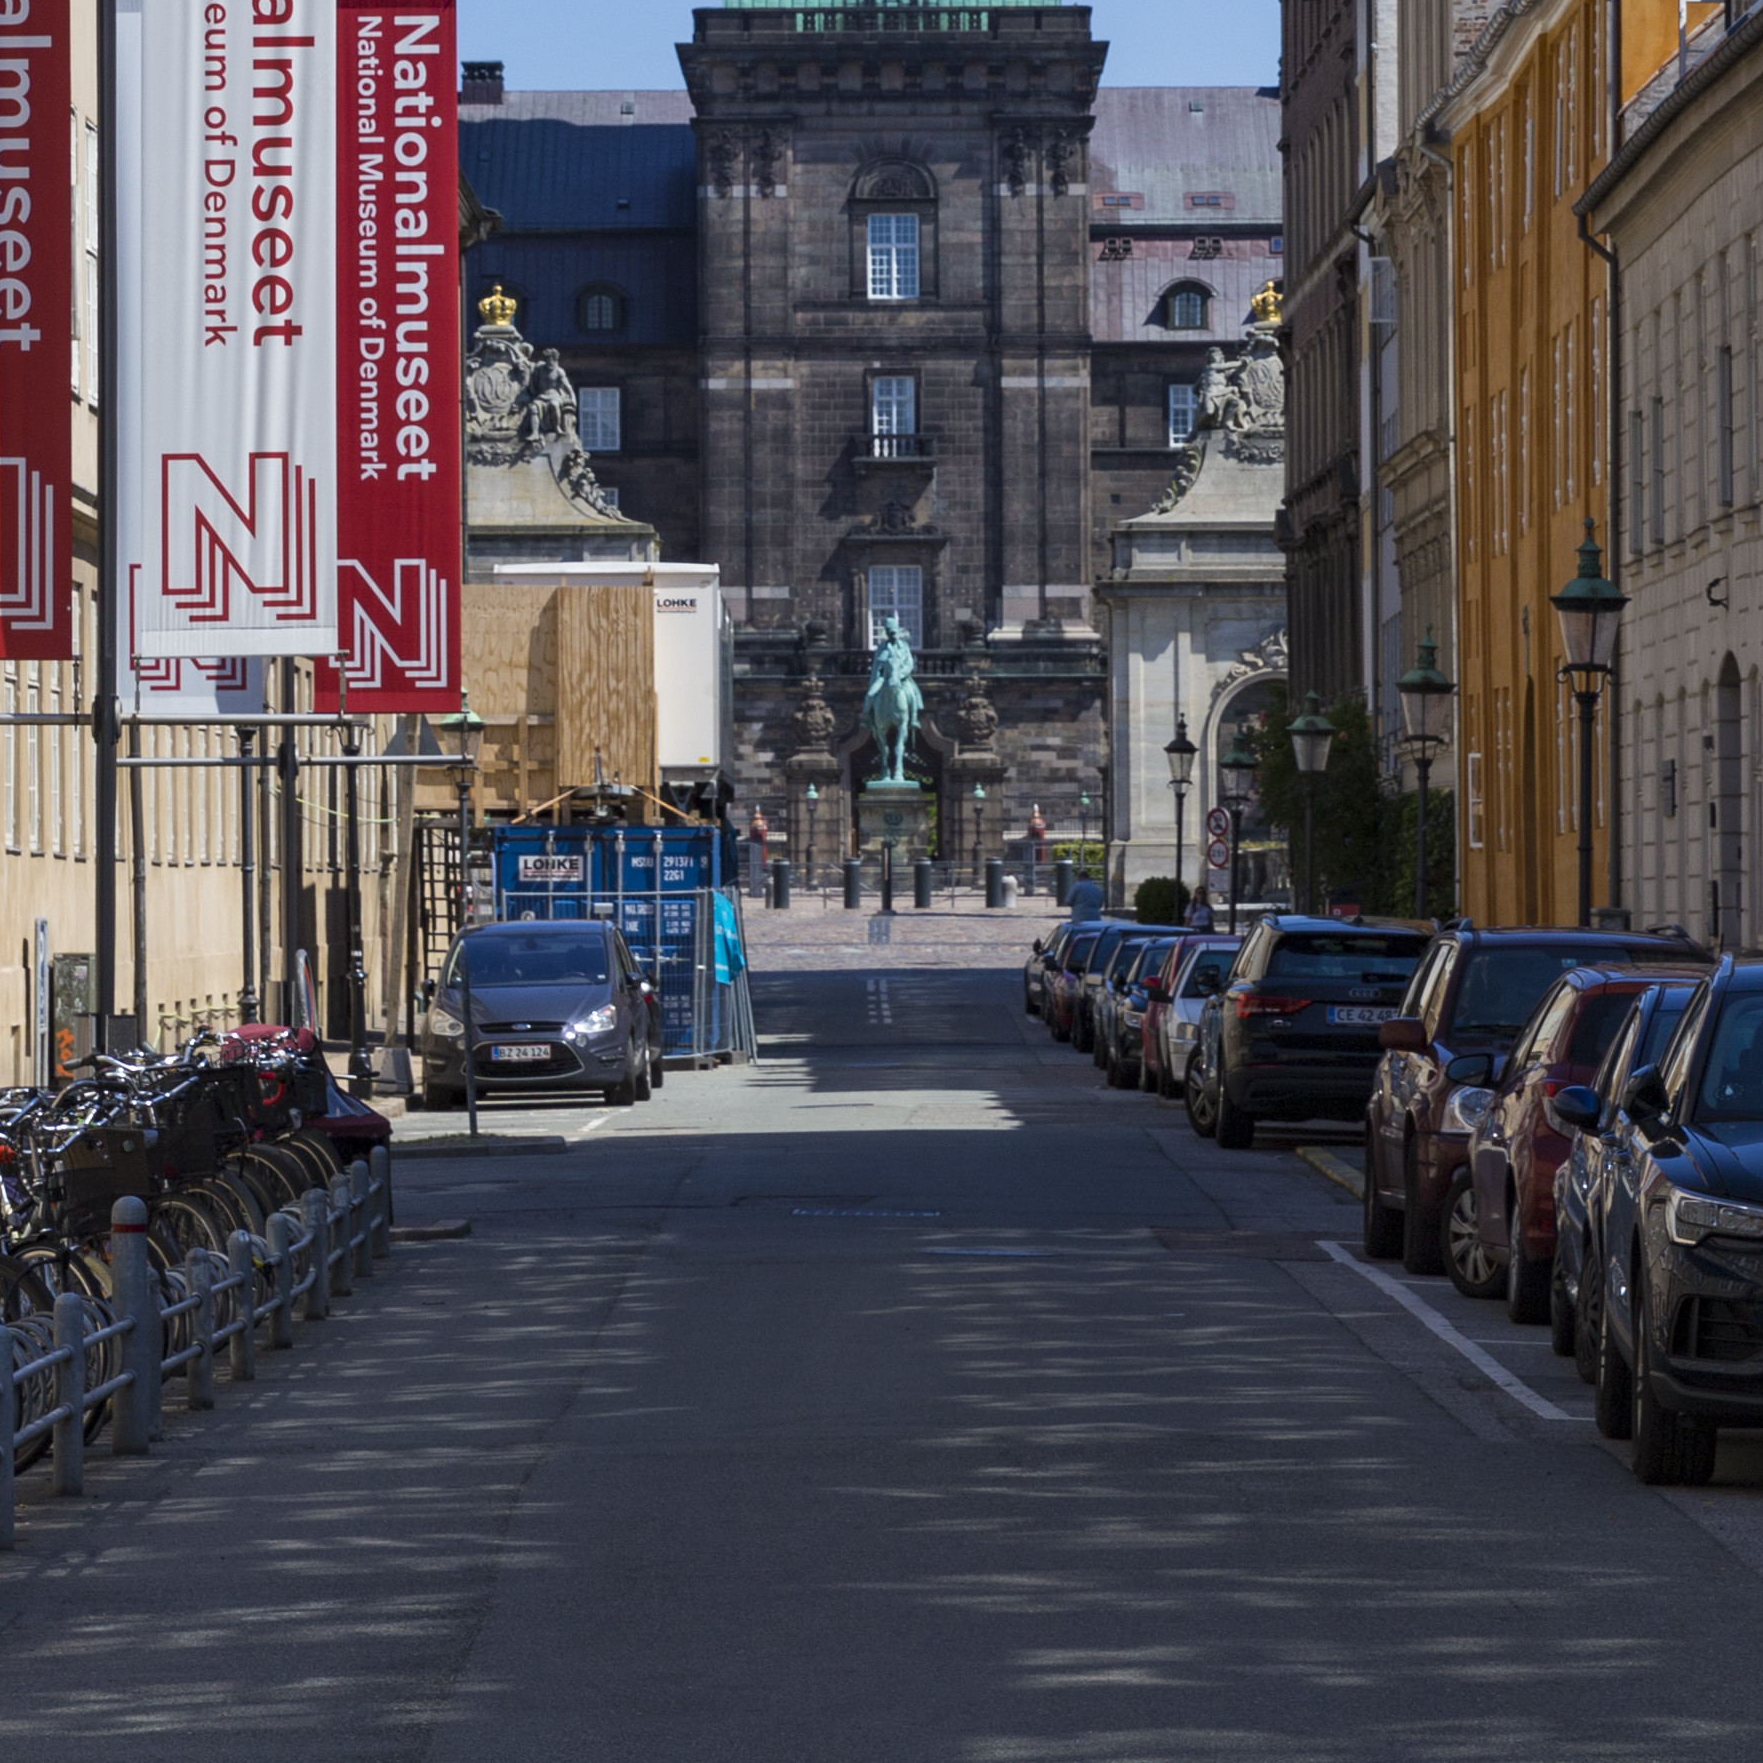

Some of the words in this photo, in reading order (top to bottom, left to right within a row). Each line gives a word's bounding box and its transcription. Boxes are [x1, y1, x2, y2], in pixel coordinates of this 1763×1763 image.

[357, 15, 385, 144] National
[204, 106, 238, 146] of
[204, 159, 238, 346] Denmark
[358, 153, 384, 288] Museum
[392, 13, 445, 482] Nationalmuseet
[359, 297, 387, 330] of
[359, 337, 387, 480] Denmark
[161, 451, 316, 622] N
[657, 598, 697, 607] LOHKE
[523, 858, 579, 870] LOHKE
[499, 1048, 513, 1058] BZ
[516, 1047, 528, 1057] 24
[531, 1047, 549, 1057] 124
[1337, 1008, 1355, 1021] CE
[1358, 1009, 1374, 1022] 42
